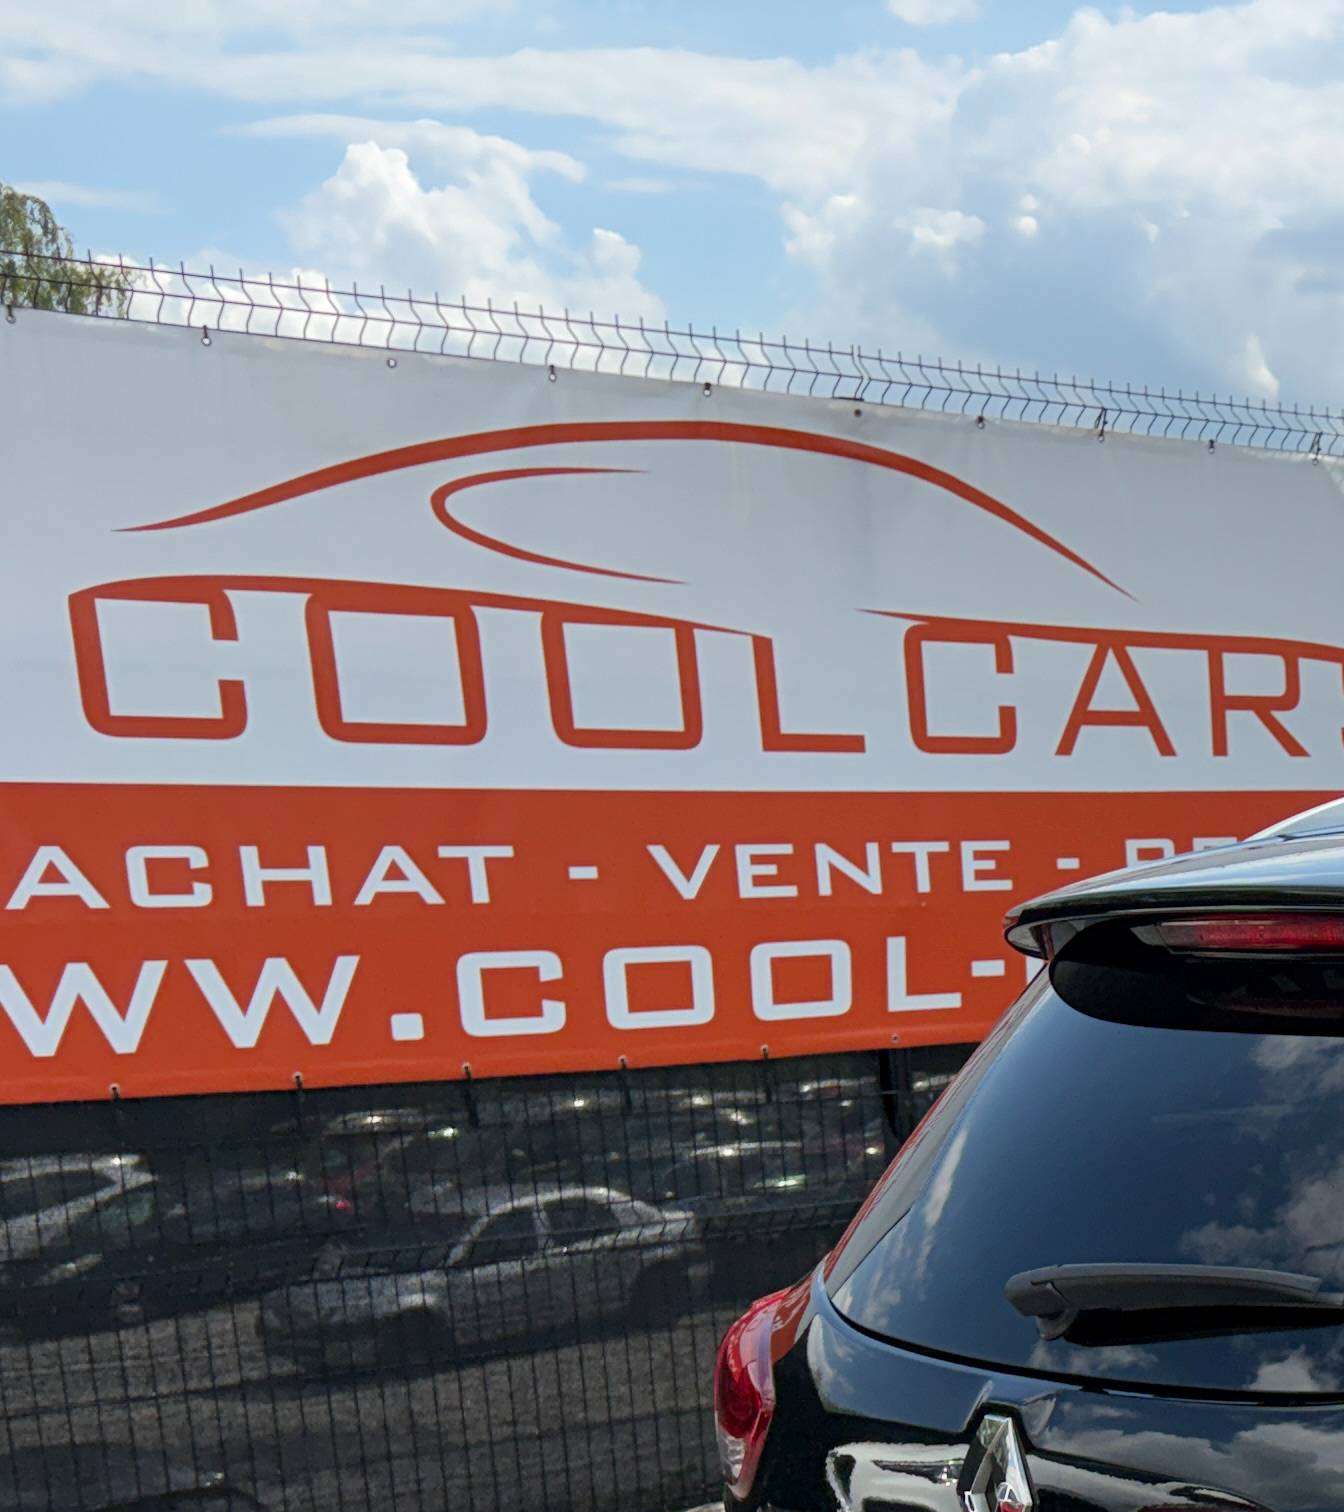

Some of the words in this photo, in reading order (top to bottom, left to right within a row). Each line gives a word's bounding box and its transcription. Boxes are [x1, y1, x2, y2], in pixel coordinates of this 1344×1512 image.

[4, 844, 515, 910] ACHAT
[645, 840, 1014, 900] VENTE
[0, 936, 1047, 1058] WW.COOL-
